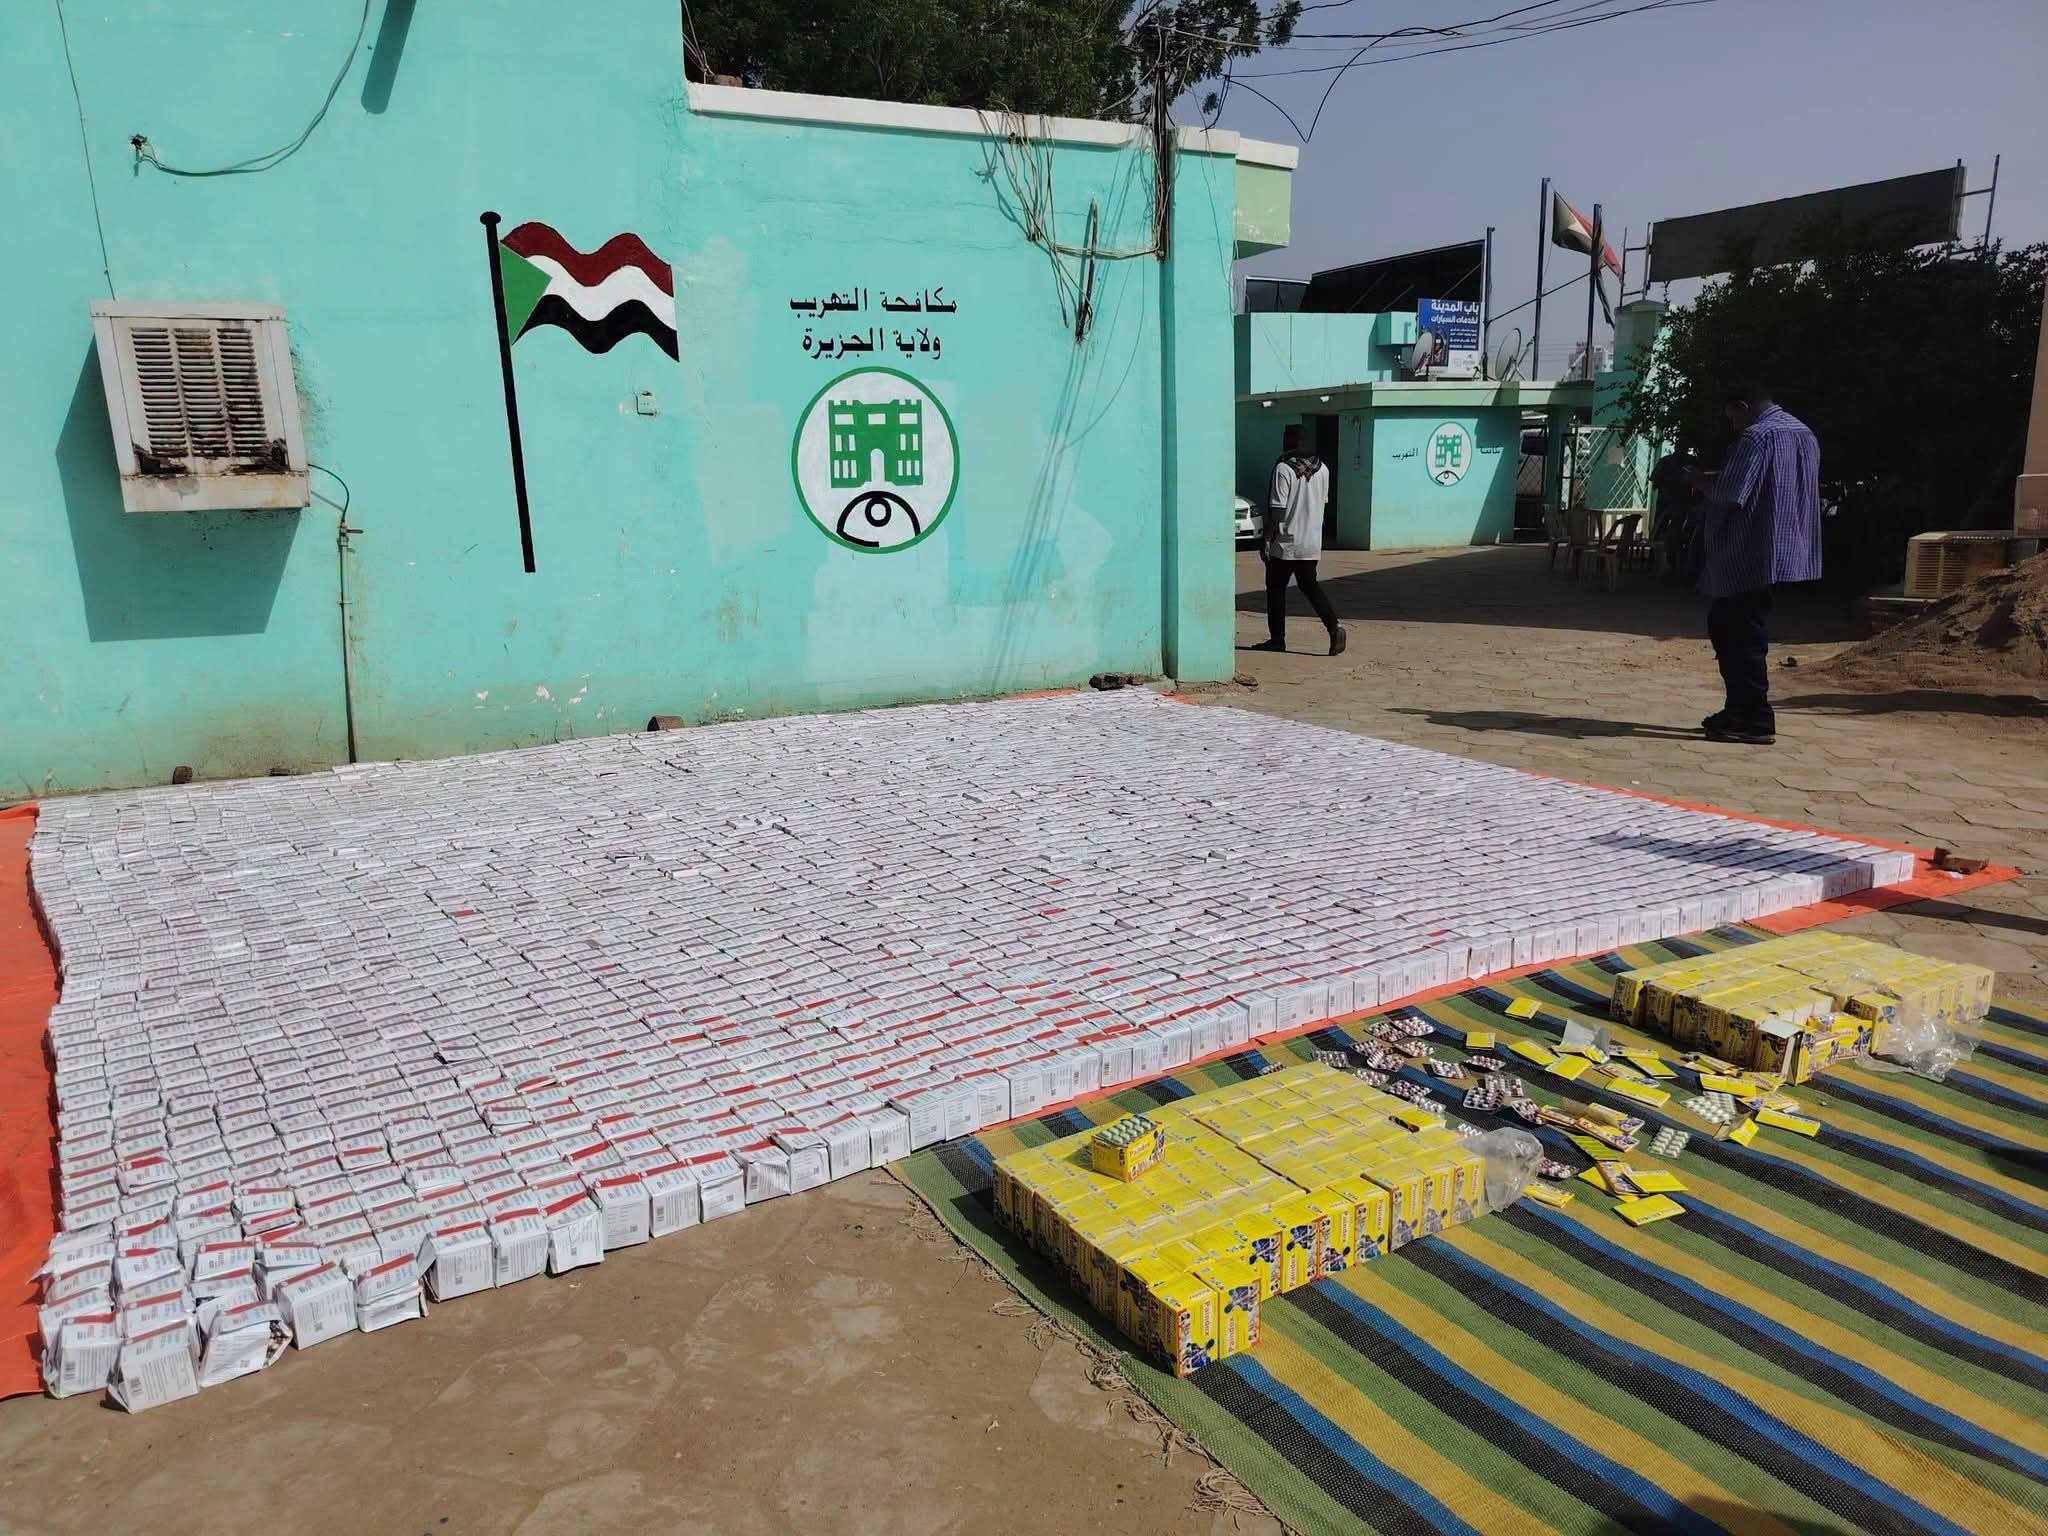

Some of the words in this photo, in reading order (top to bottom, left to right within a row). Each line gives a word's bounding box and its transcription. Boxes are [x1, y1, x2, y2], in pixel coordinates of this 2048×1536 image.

[789, 287, 868, 319] التهريب
[879, 286, 958, 313] مكافحة
[1431, 299, 1463, 314] المدينة
[1463, 301, 1480, 315] باب
[1430, 314, 1456, 325] السيارات
[1456, 315, 1479, 325] لخدمات
[801, 327, 884, 360] الجزيرة
[893, 327, 942, 360] ولاية
[1391, 447, 1419, 460] التهريب
